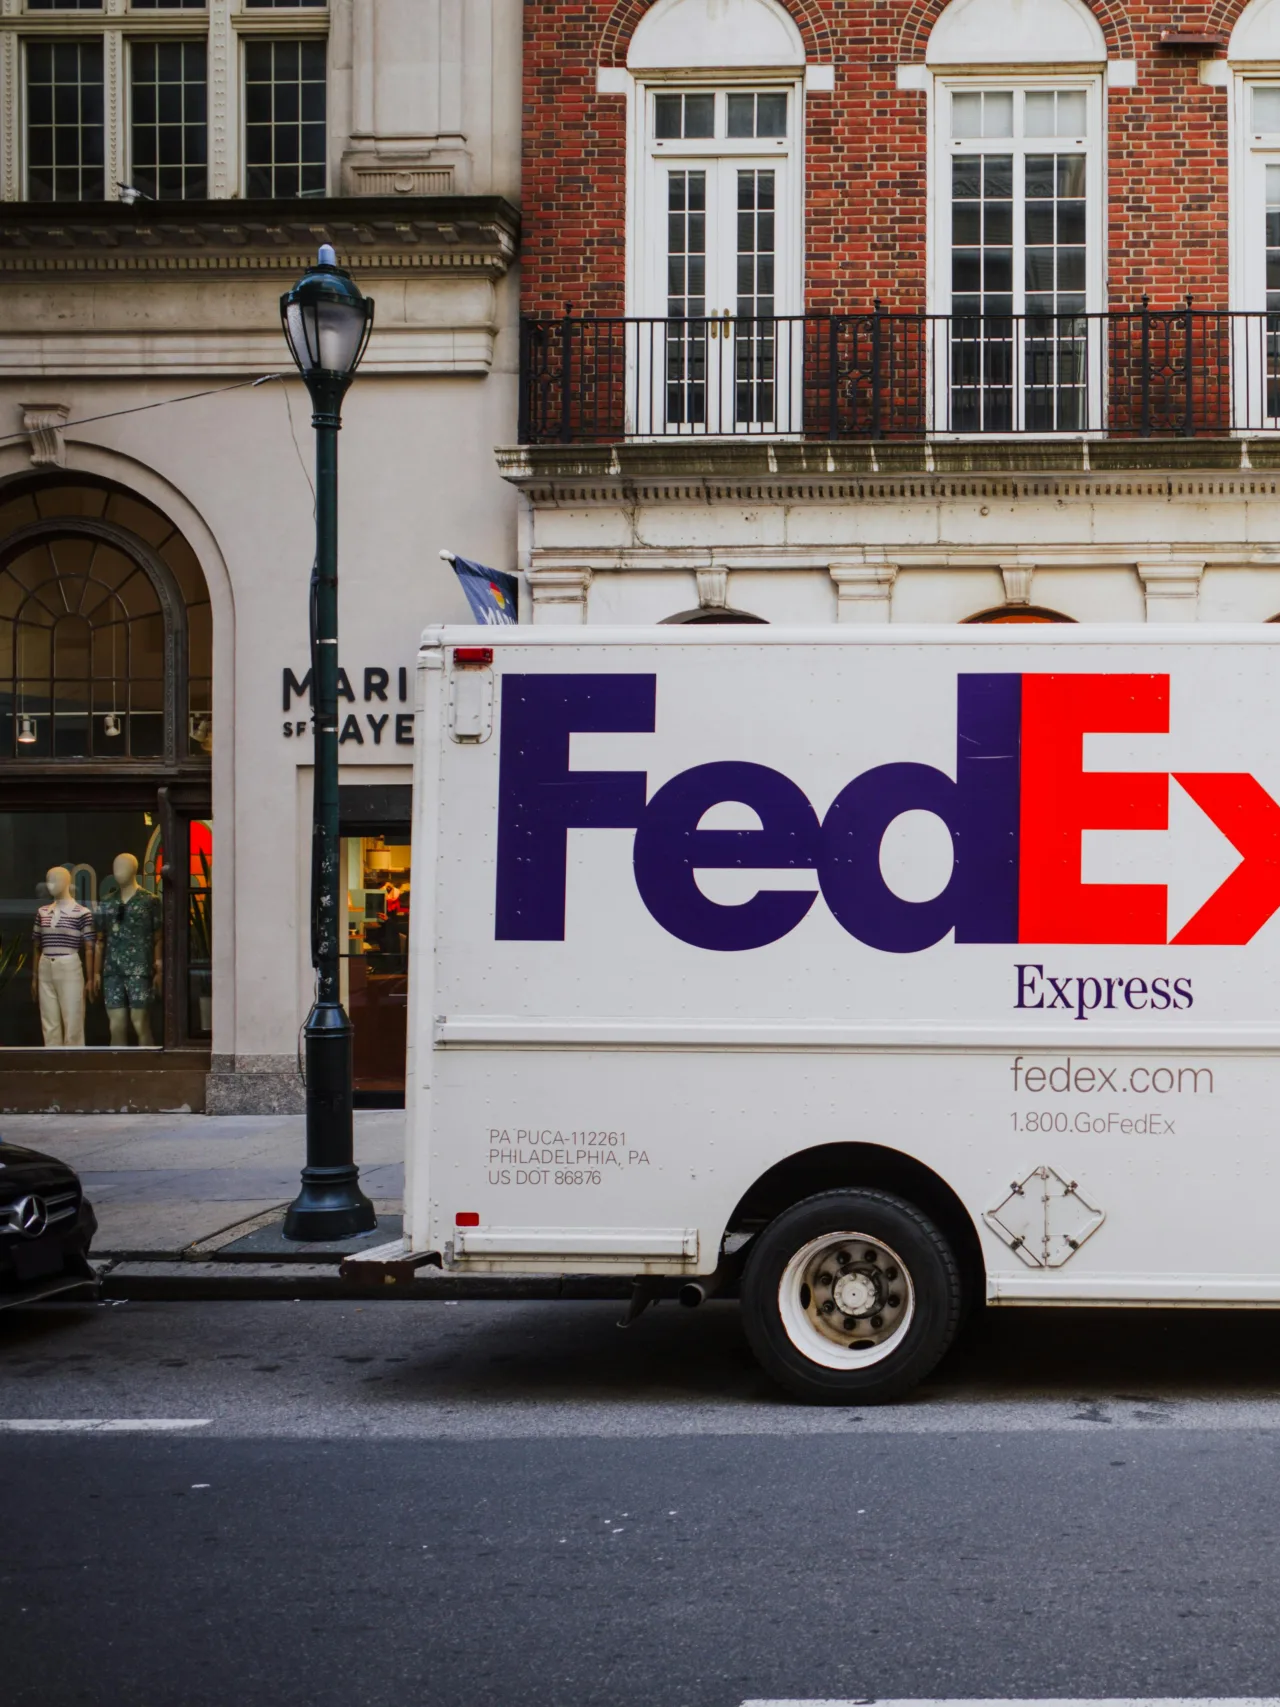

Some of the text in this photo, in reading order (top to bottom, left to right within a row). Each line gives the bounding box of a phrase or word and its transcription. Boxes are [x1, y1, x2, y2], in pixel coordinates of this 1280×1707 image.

[1013, 964, 1194, 1020] Express
[1010, 1056, 1214, 1093] fedex.com
[1010, 1111, 1176, 1135] 1.800.GoFedEx
[489, 1129, 626, 1146] PA PUCA-112261
[489, 1149, 650, 1166] PHILADELPHIA, PA
[488, 1170, 602, 1185] US DOT 86876
